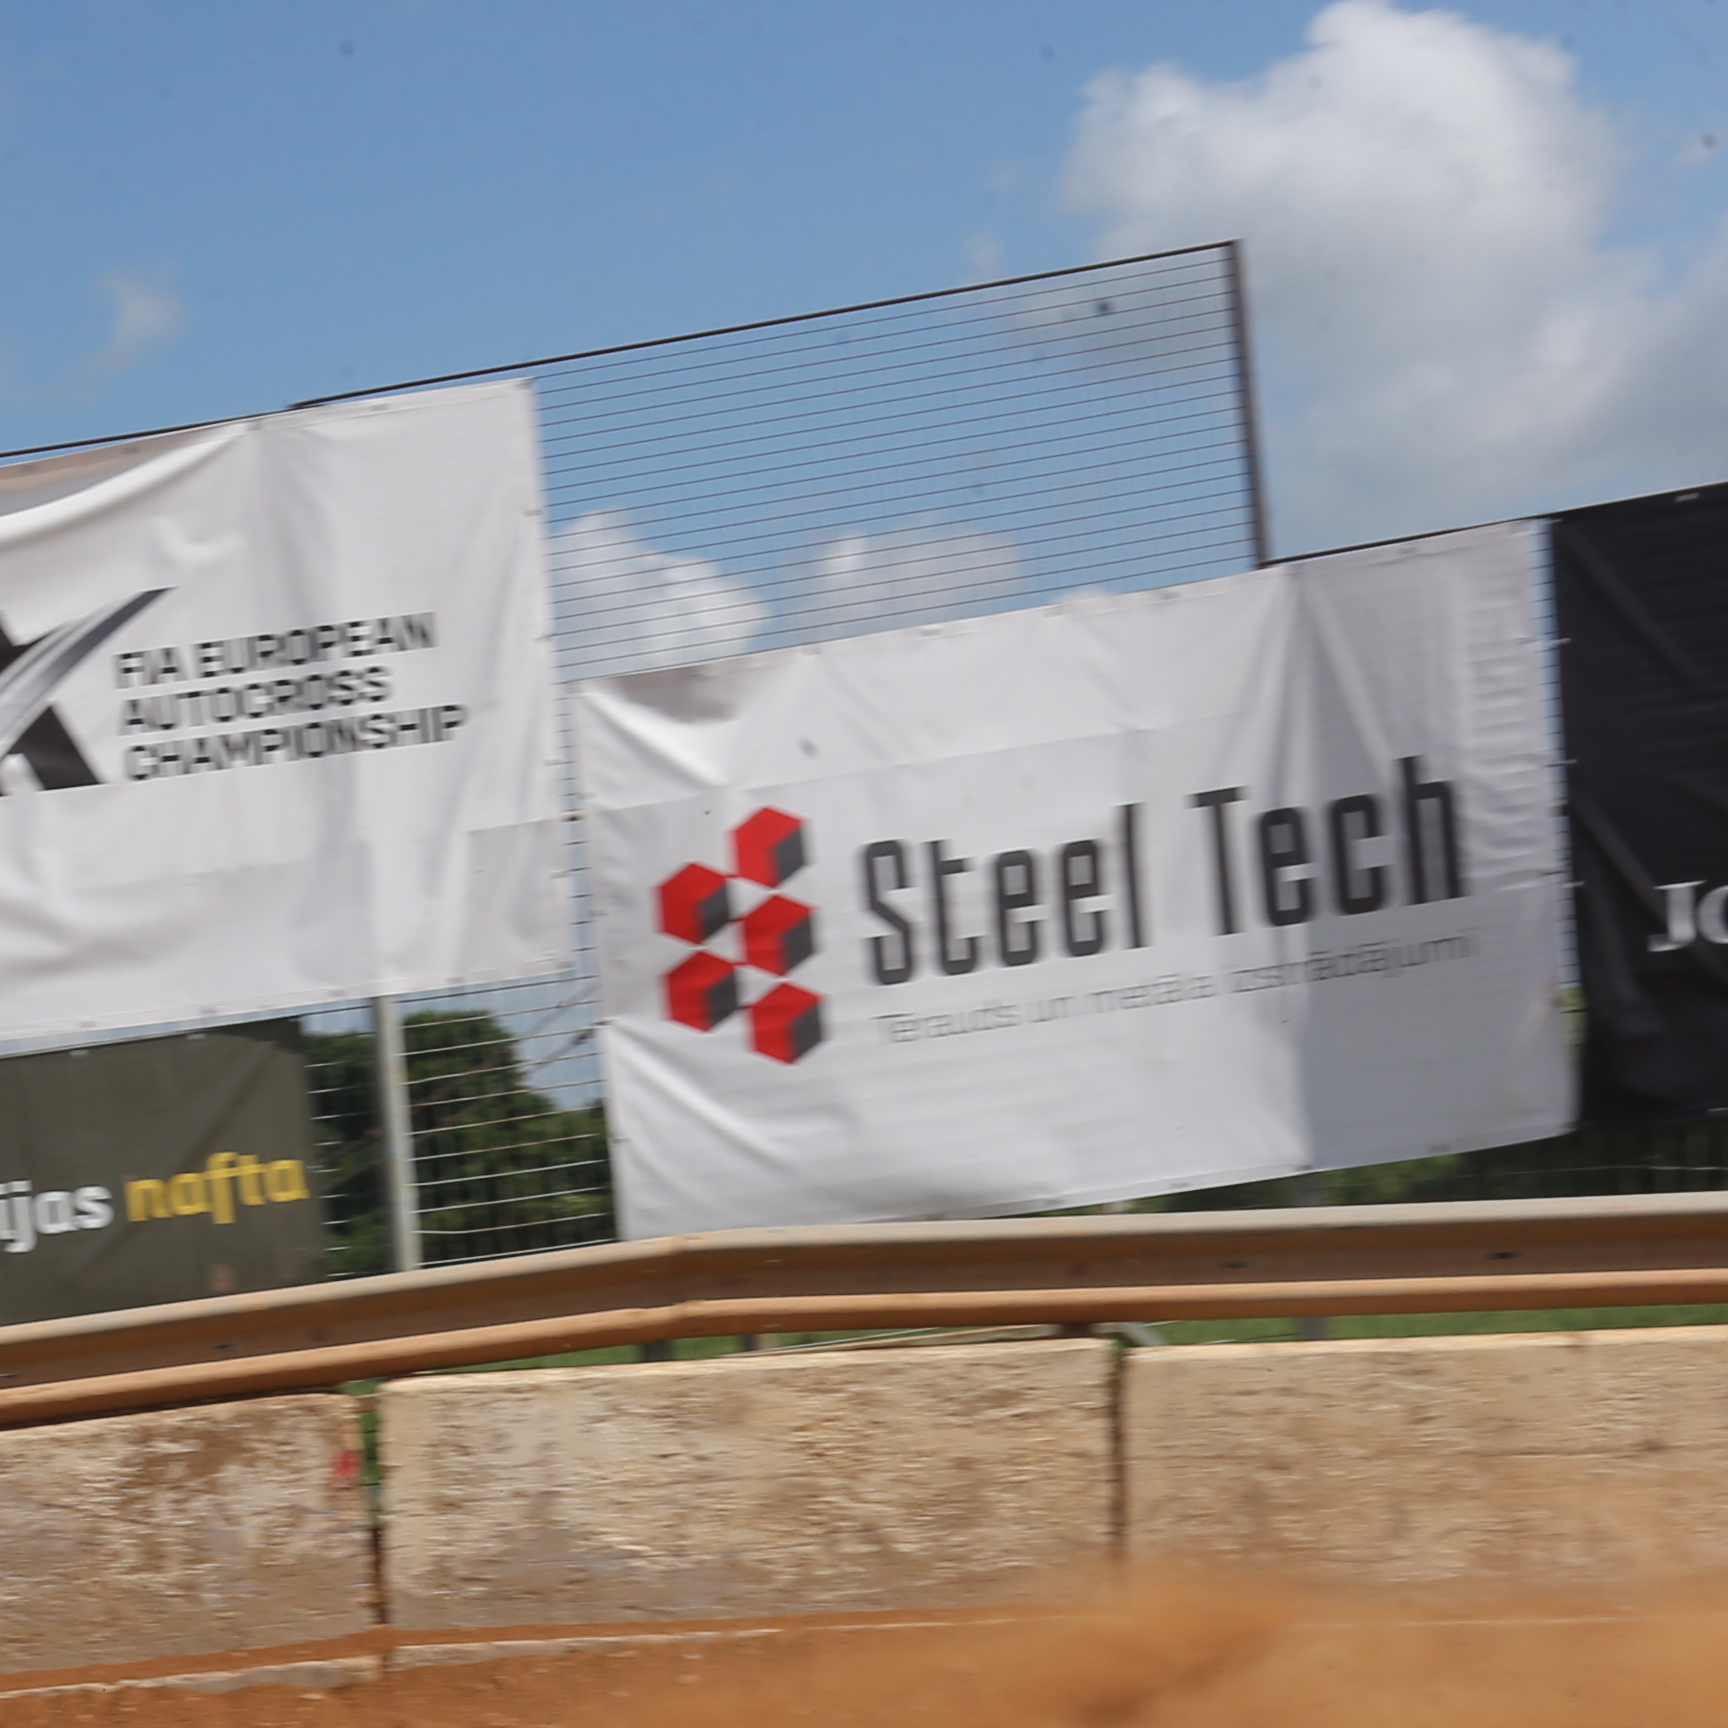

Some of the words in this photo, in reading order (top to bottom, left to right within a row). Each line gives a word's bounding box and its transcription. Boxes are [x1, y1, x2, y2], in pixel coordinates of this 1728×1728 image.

[114, 648, 186, 690] FIA
[194, 611, 437, 680] EUROPEAN
[118, 666, 392, 736] AUTOCROSS
[125, 703, 468, 781] CHAMPIONSHIP
[860, 802, 1154, 986] Steel
[1185, 754, 1471, 936] Tech
[124, 1151, 310, 1224] nafta
